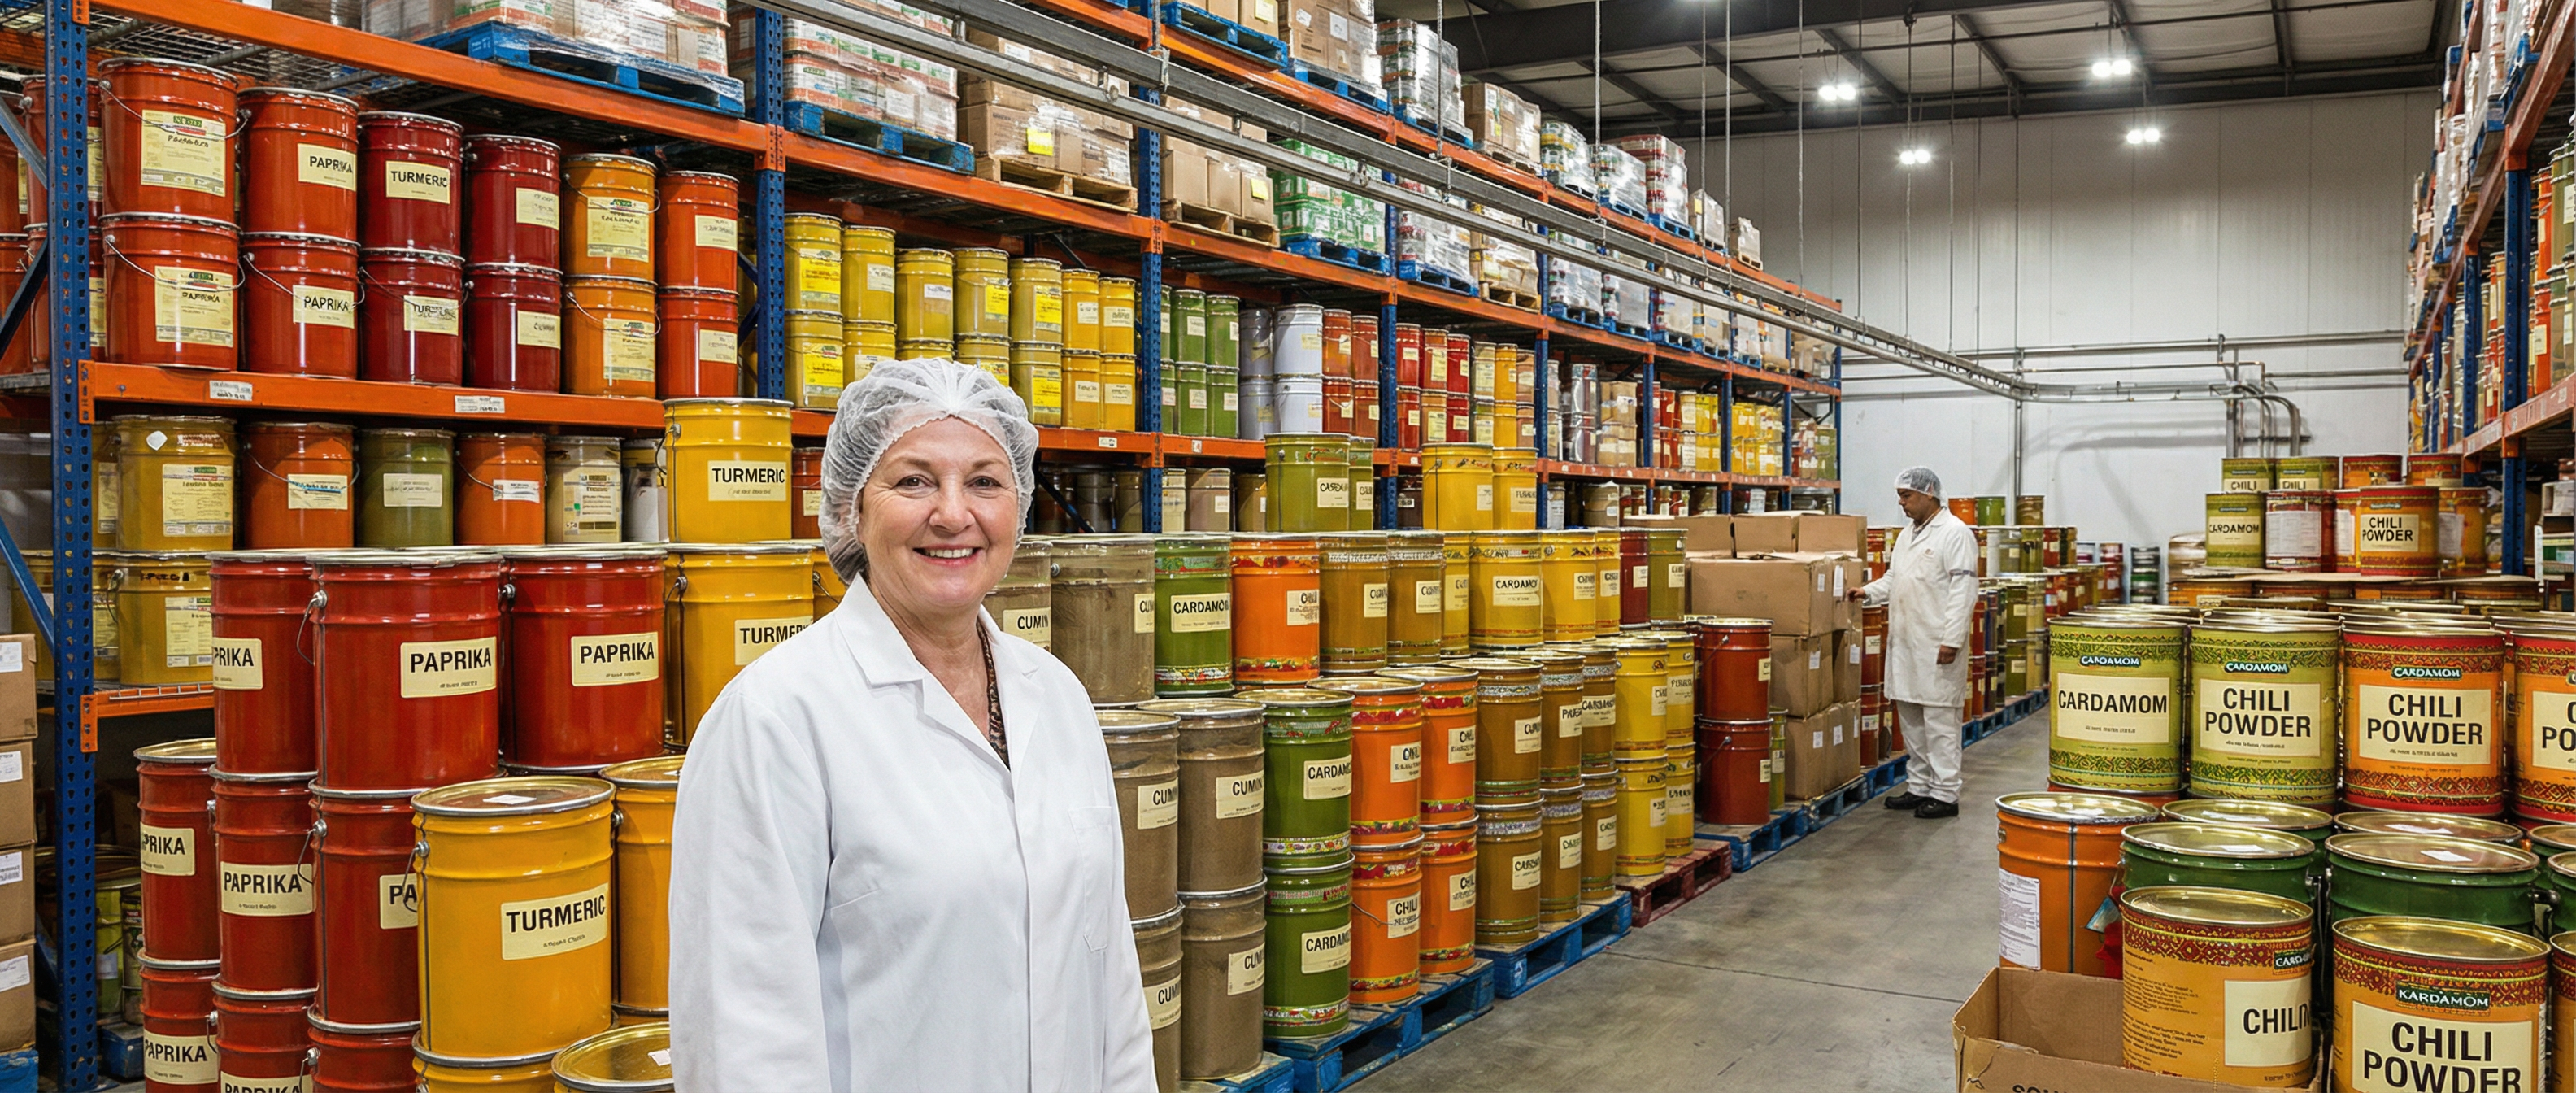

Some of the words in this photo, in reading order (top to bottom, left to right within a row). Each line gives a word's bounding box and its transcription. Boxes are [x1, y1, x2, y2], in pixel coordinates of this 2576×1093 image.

[712, 467, 785, 485] TURMERIC
[2369, 516, 2402, 529] CHILI
[410, 647, 492, 673] PAPRIKA
[580, 642, 655, 664] PAPRIKA
[2058, 690, 2168, 714] CARDAMOM
[2223, 687, 2290, 712] CHILI
[2388, 693, 2461, 718] CHILI
[2205, 711, 2312, 738] POWDER
[2367, 717, 2482, 745] POWDER
[224, 872, 302, 894] PAPRIKA
[505, 894, 606, 934] TURMERIC
[2399, 989, 2489, 1008] KARDAMOM
[2391, 1021, 2492, 1062] CHILI
